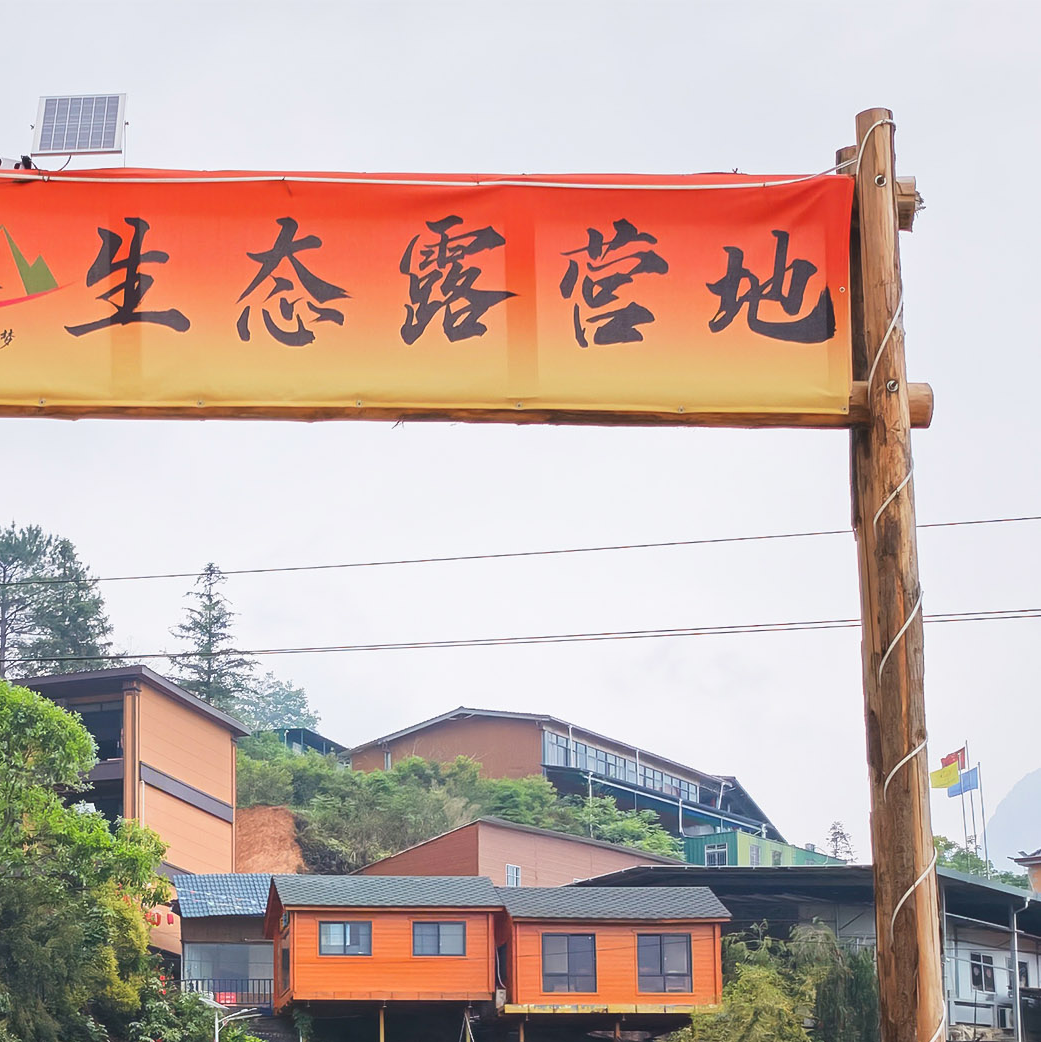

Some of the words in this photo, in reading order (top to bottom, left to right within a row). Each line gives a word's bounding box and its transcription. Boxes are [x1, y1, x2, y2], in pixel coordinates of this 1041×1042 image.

[63, 214, 836, 347] 生态露营地
